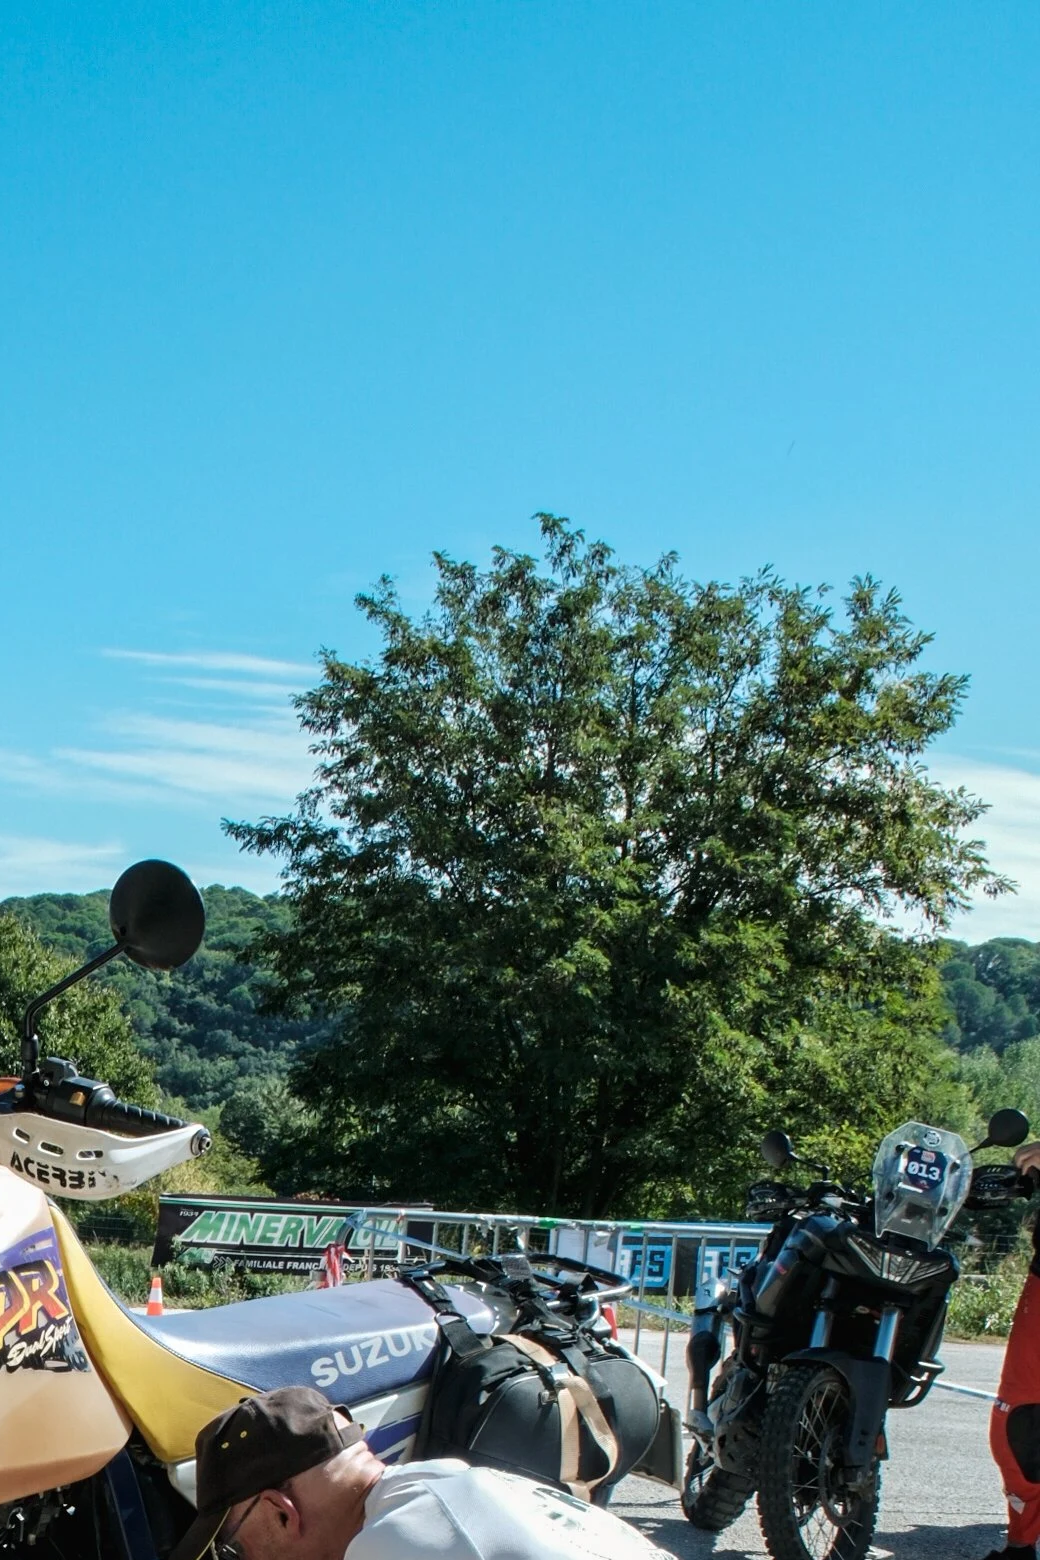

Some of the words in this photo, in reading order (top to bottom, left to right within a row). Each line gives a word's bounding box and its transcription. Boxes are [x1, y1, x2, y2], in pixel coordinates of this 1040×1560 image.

[10, 1152, 119, 1189] ACERBI
[908, 1162, 940, 1181] 013
[180, 1210, 348, 1248] MINERVA
[343, 1263, 377, 1272] DEPUS
[311, 1330, 435, 1387] SUZUK
